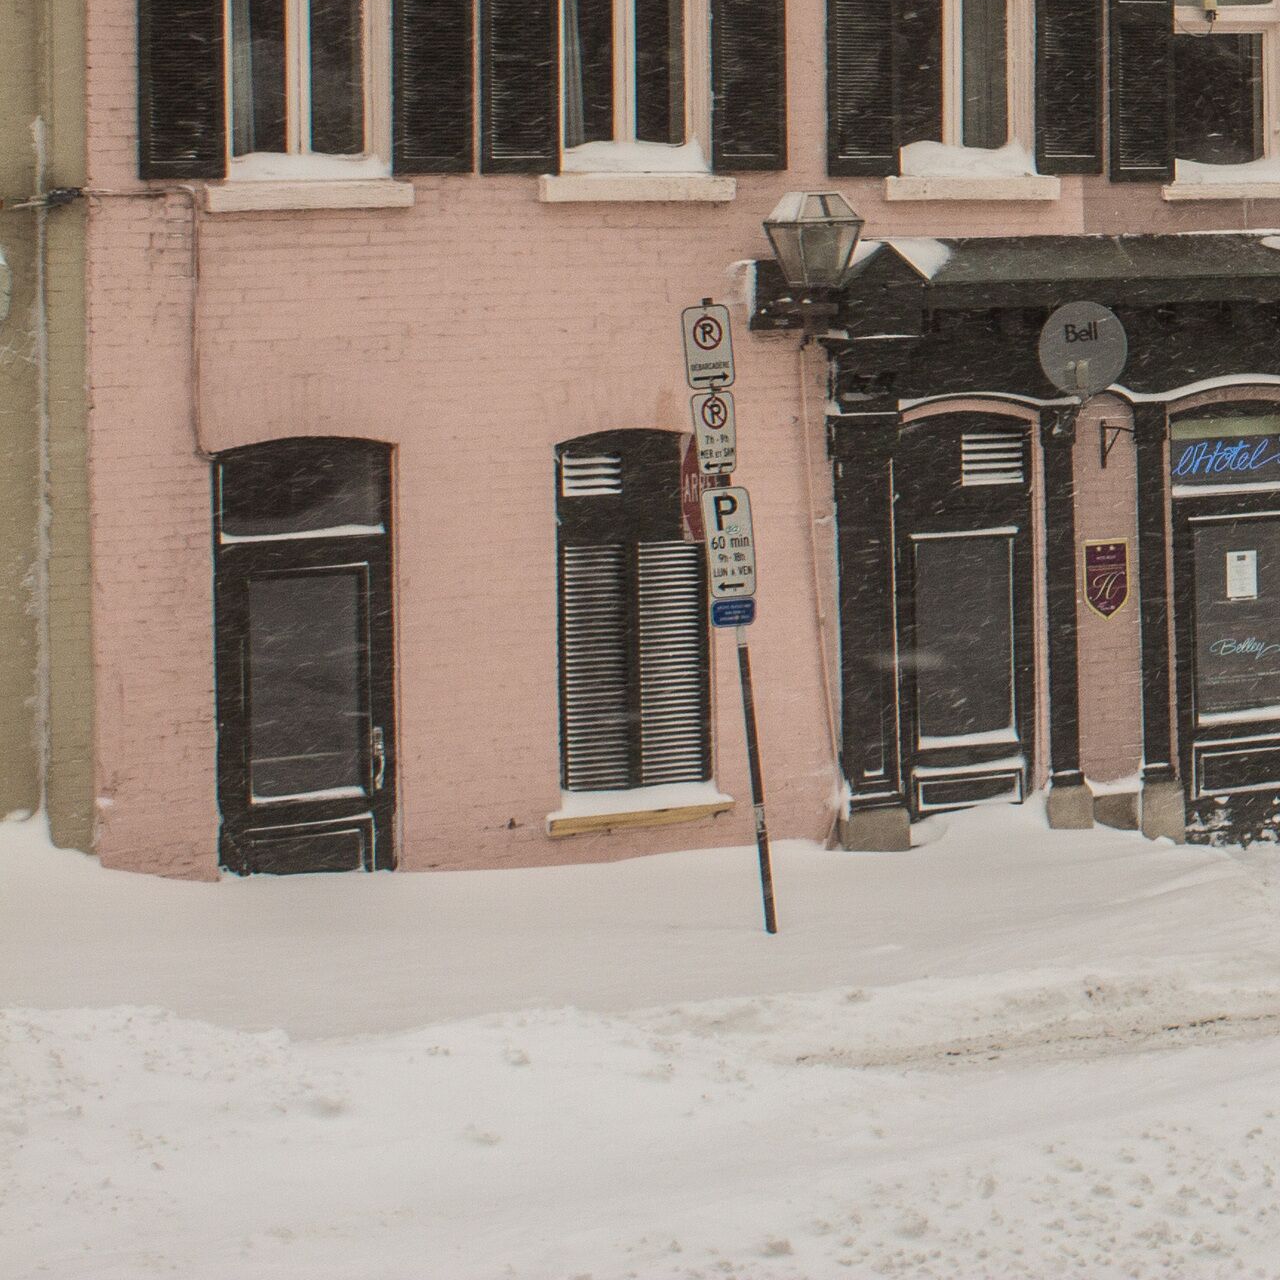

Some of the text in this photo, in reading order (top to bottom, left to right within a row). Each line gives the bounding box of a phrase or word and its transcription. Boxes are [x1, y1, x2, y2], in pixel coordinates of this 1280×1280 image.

[1064, 321, 1098, 343] Bell
[714, 495, 738, 531] P
[712, 533, 750, 550] 60 min
[1209, 638, 1280, 660] Belley
